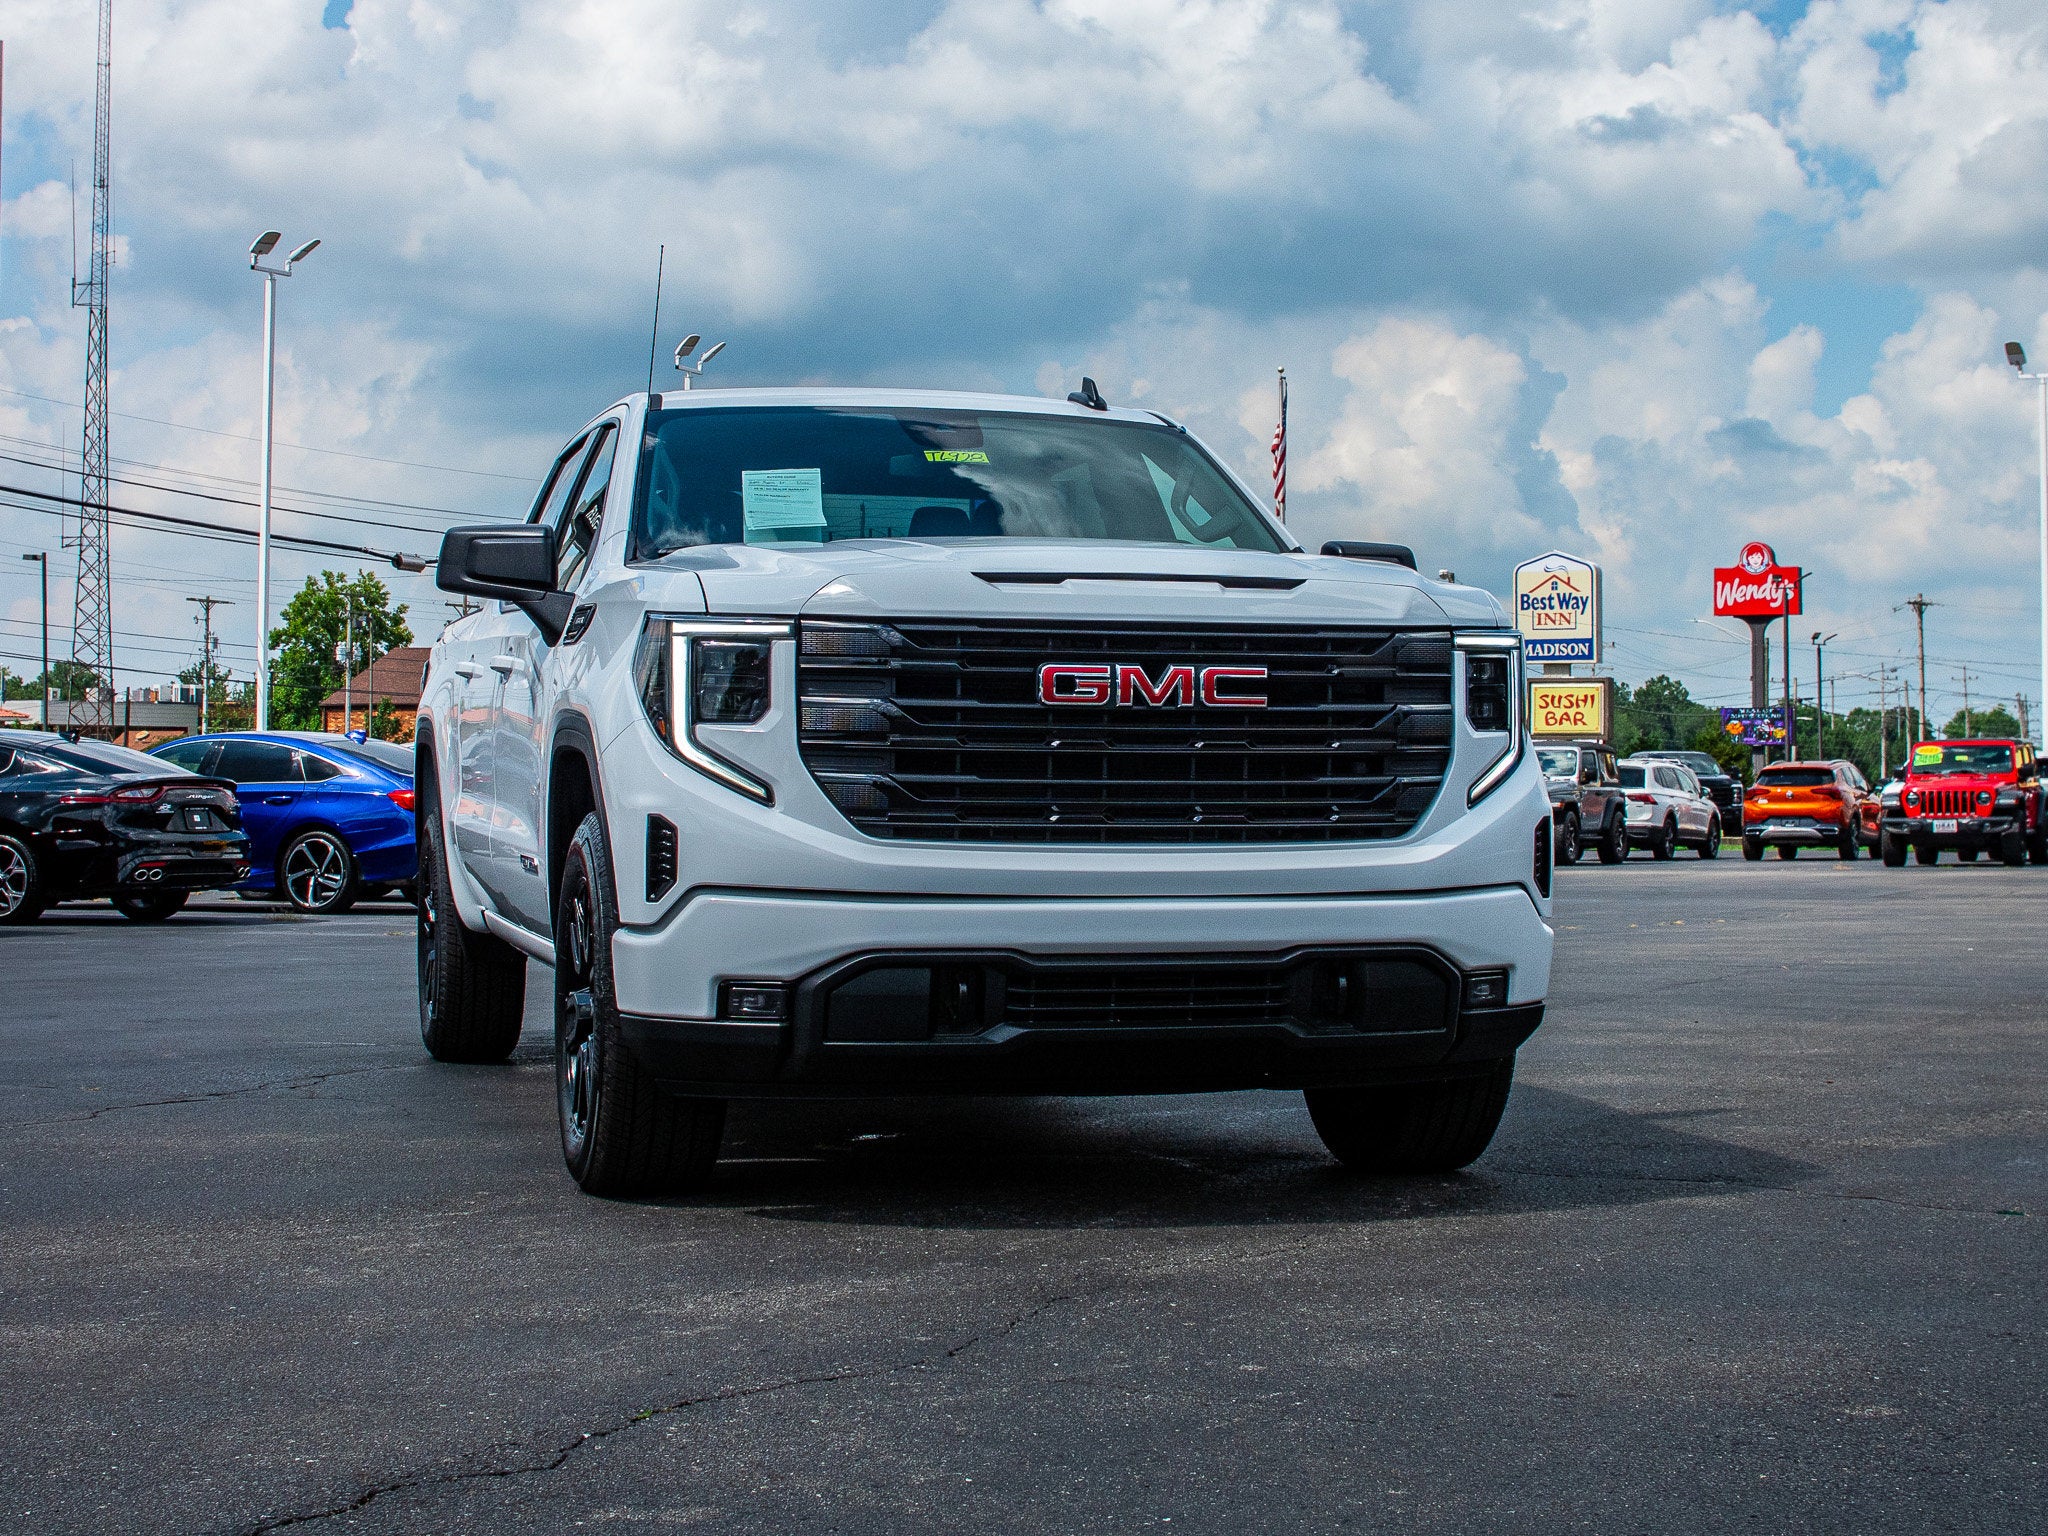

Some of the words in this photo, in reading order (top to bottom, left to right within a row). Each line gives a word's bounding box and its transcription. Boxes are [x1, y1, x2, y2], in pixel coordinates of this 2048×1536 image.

[1716, 574, 1795, 609] Wendy's
[1520, 593, 1555, 611] Best
[1556, 592, 1589, 615] Way
[1536, 612, 1572, 626] INN
[1040, 664, 1268, 708] GMC
[1538, 694, 1595, 709] SUSHI
[1545, 711, 1588, 726] BAR
